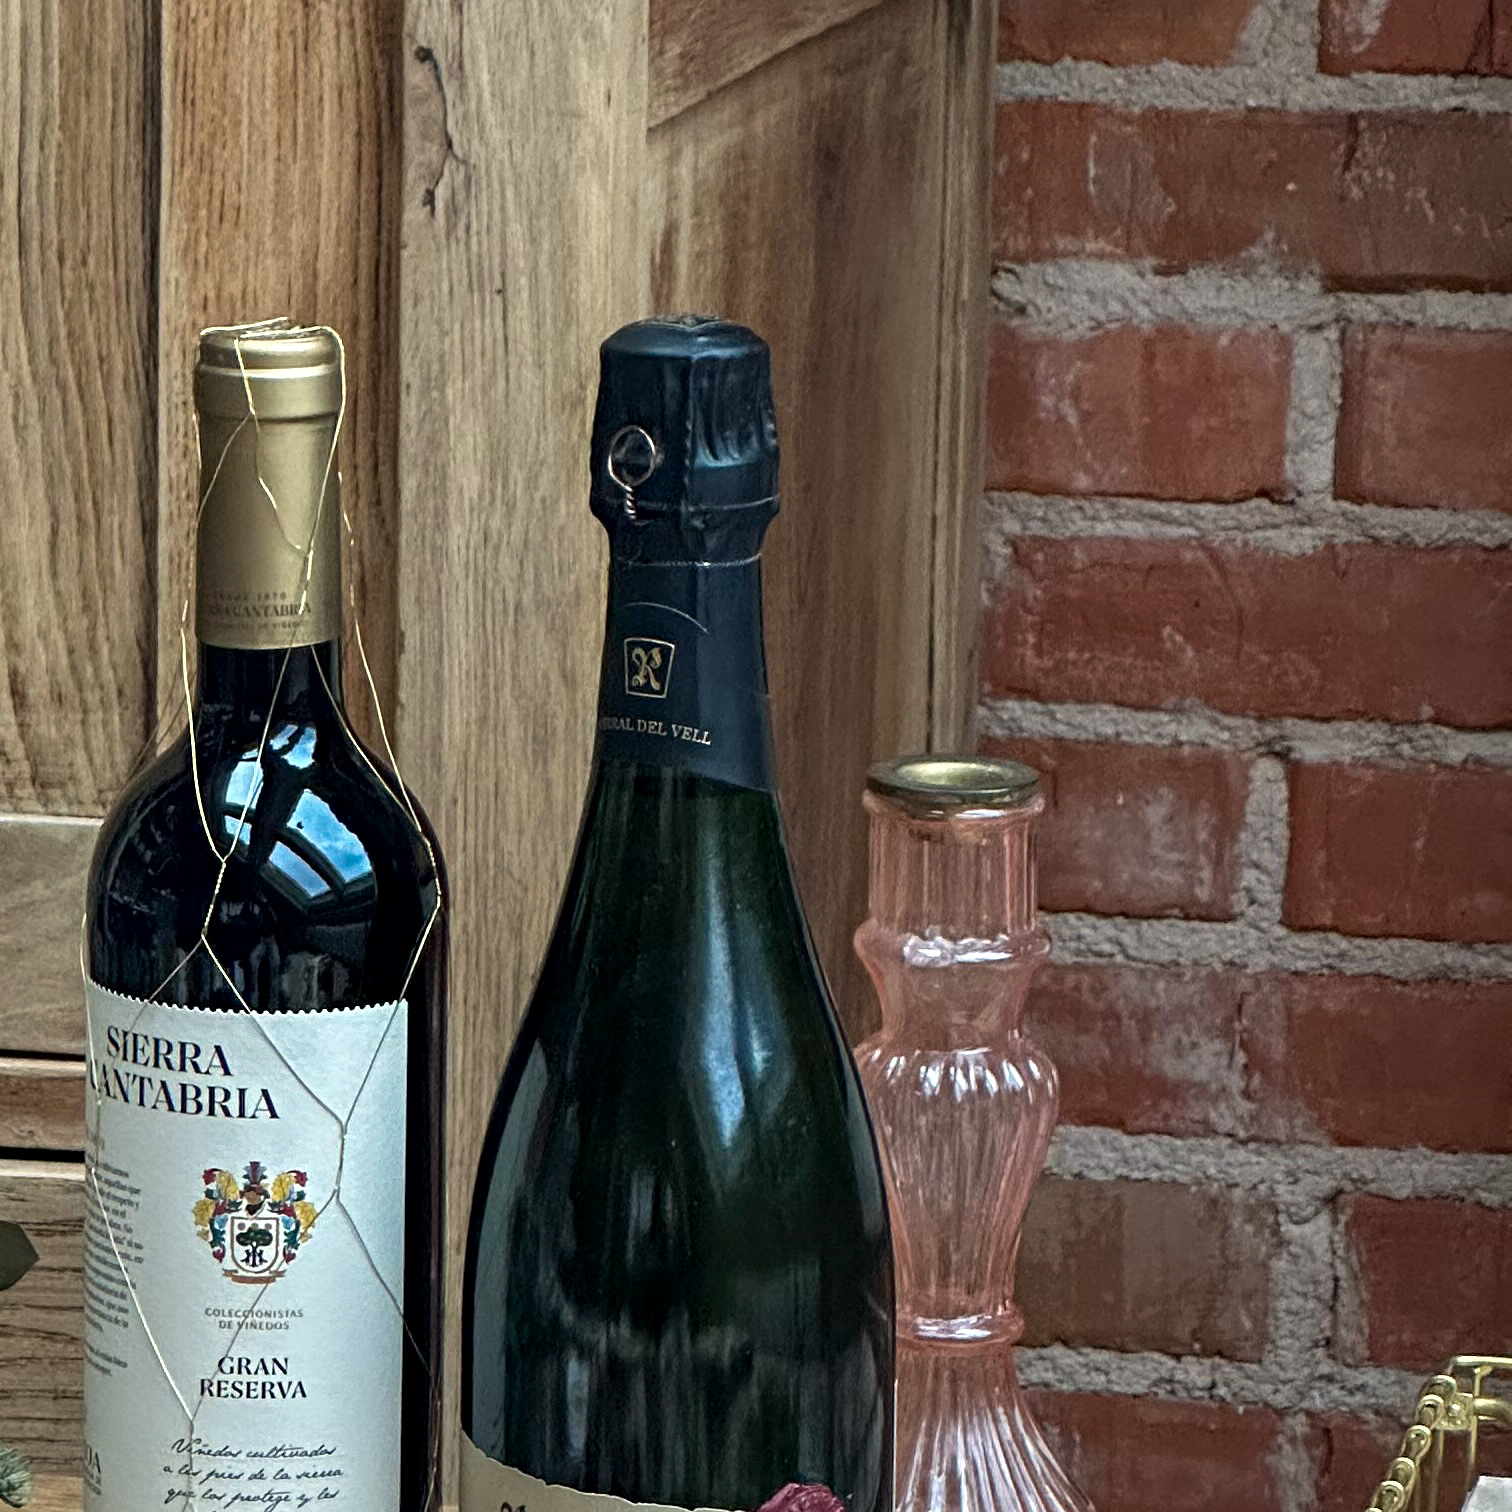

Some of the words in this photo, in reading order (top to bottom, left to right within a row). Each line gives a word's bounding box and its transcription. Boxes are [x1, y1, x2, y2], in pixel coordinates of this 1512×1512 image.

[637, 719, 668, 736] DEL
[671, 724, 713, 746] VELL
[106, 1025, 234, 1077] SIERRA
[204, 1307, 304, 1319] COLECCIONISTAS
[218, 1320, 233, 1330] DE
[217, 1356, 289, 1376] GRAN
[200, 1378, 307, 1400] RESERVA
[245, 1444, 338, 1459] cultivados
[163, 1465, 174, 1473] a
[248, 1468, 268, 1482] de
[272, 1467, 293, 1480] la
[164, 1487, 196, 1505] que
[295, 1493, 313, 1509] y
